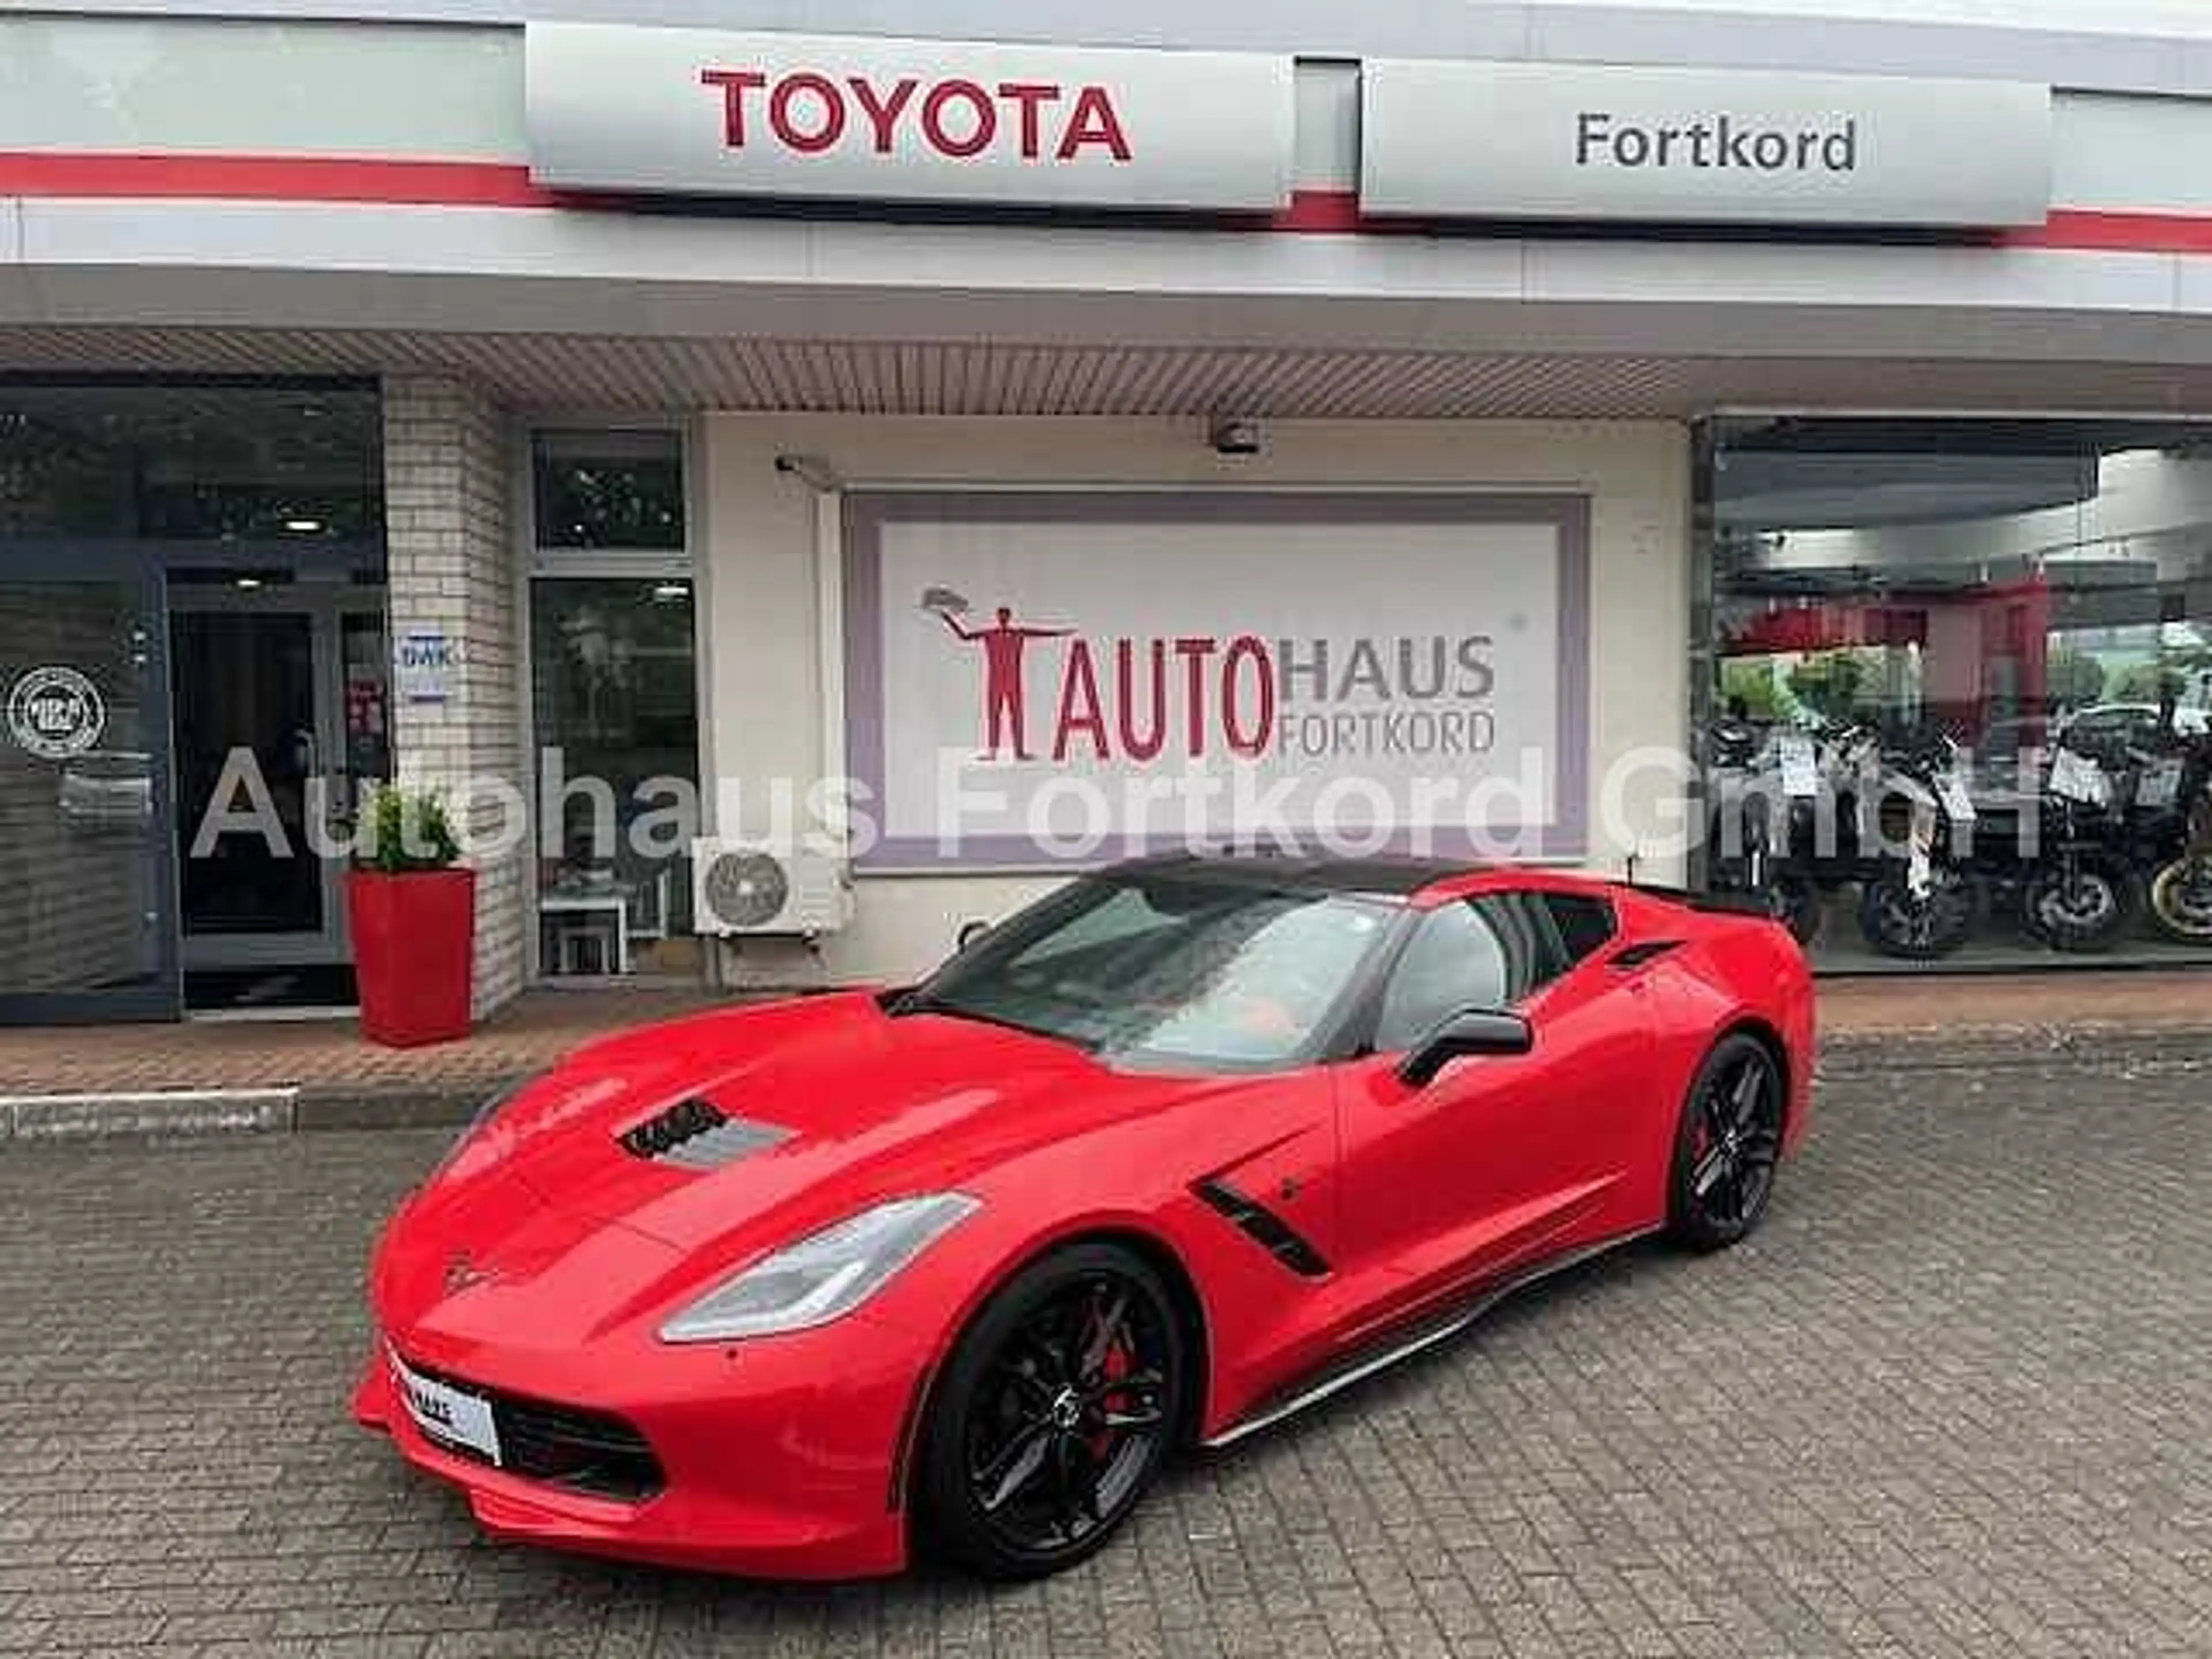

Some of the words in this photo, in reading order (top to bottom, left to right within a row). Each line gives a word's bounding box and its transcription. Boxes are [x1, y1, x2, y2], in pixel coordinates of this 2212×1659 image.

[701, 69, 1132, 162] TOYOTA
[1575, 113, 1857, 171] Fortkord
[1278, 710, 1495, 756] FORTKORD
